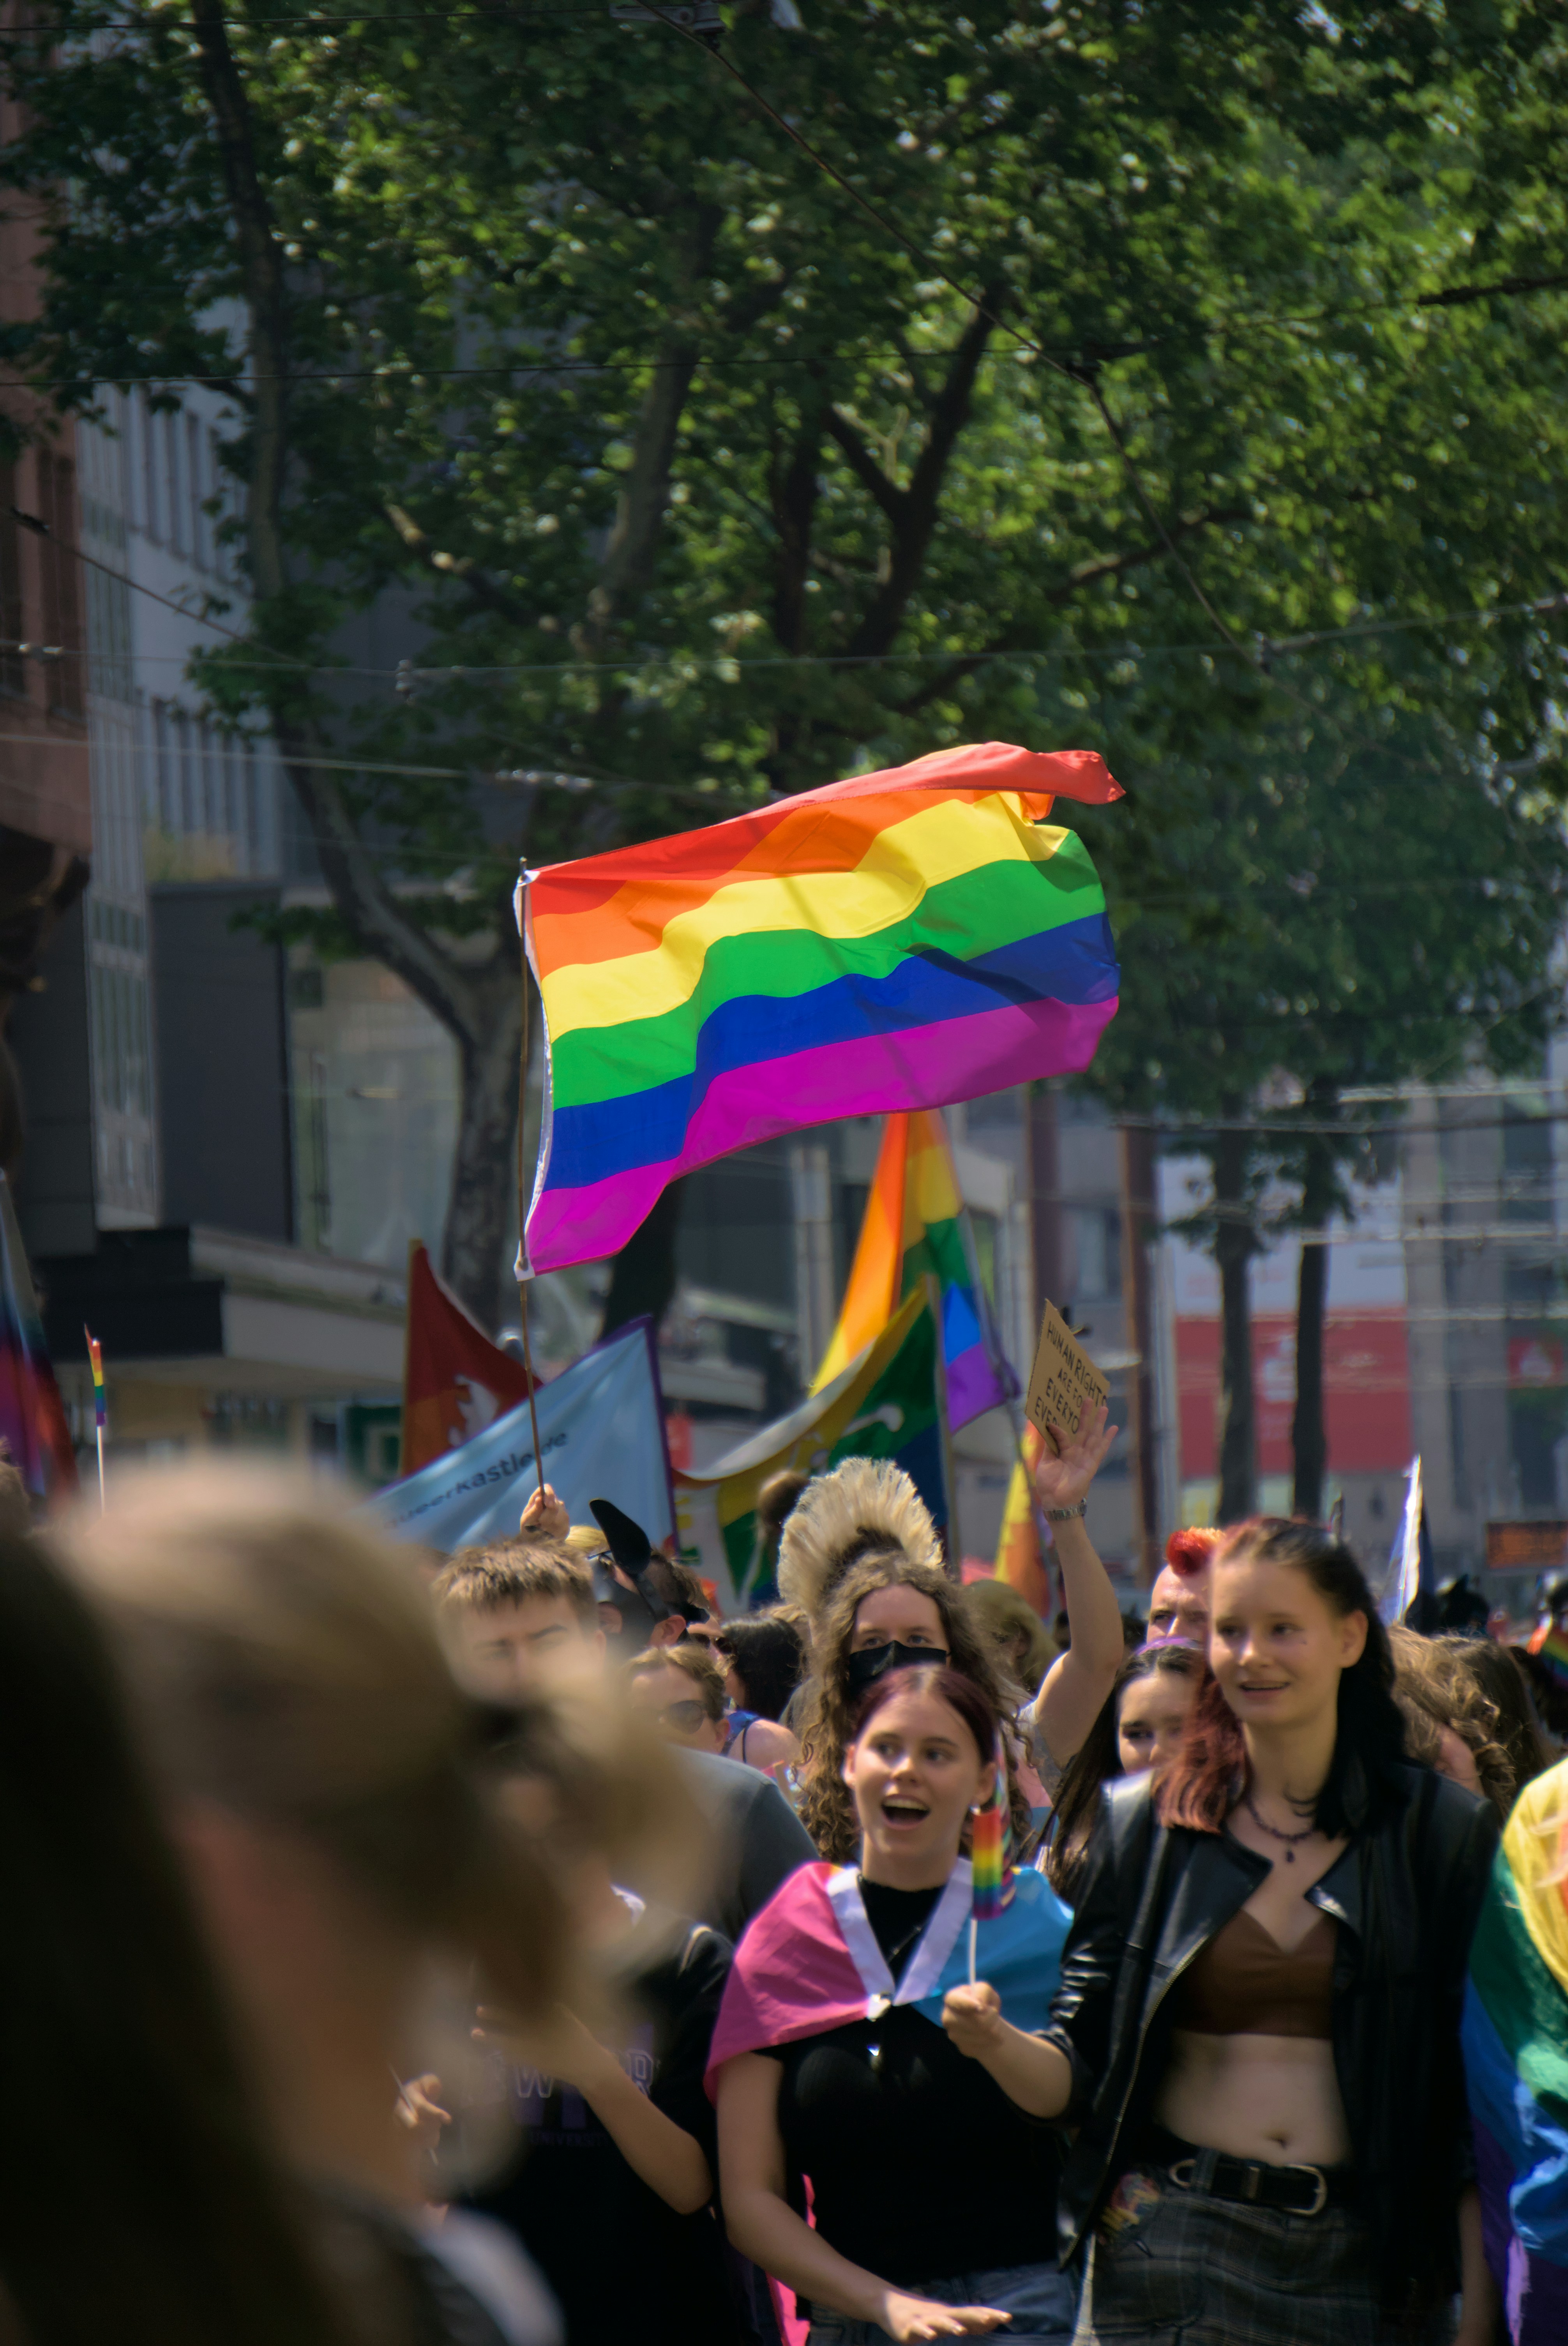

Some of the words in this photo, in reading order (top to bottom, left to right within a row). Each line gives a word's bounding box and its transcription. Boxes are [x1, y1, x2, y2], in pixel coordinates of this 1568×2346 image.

[1047, 1320, 1075, 1370] HUMAN
[1046, 1378, 1080, 1434] EVERYO
[1058, 1367, 1073, 1394] ARE
[1073, 1387, 1083, 1408] FO
